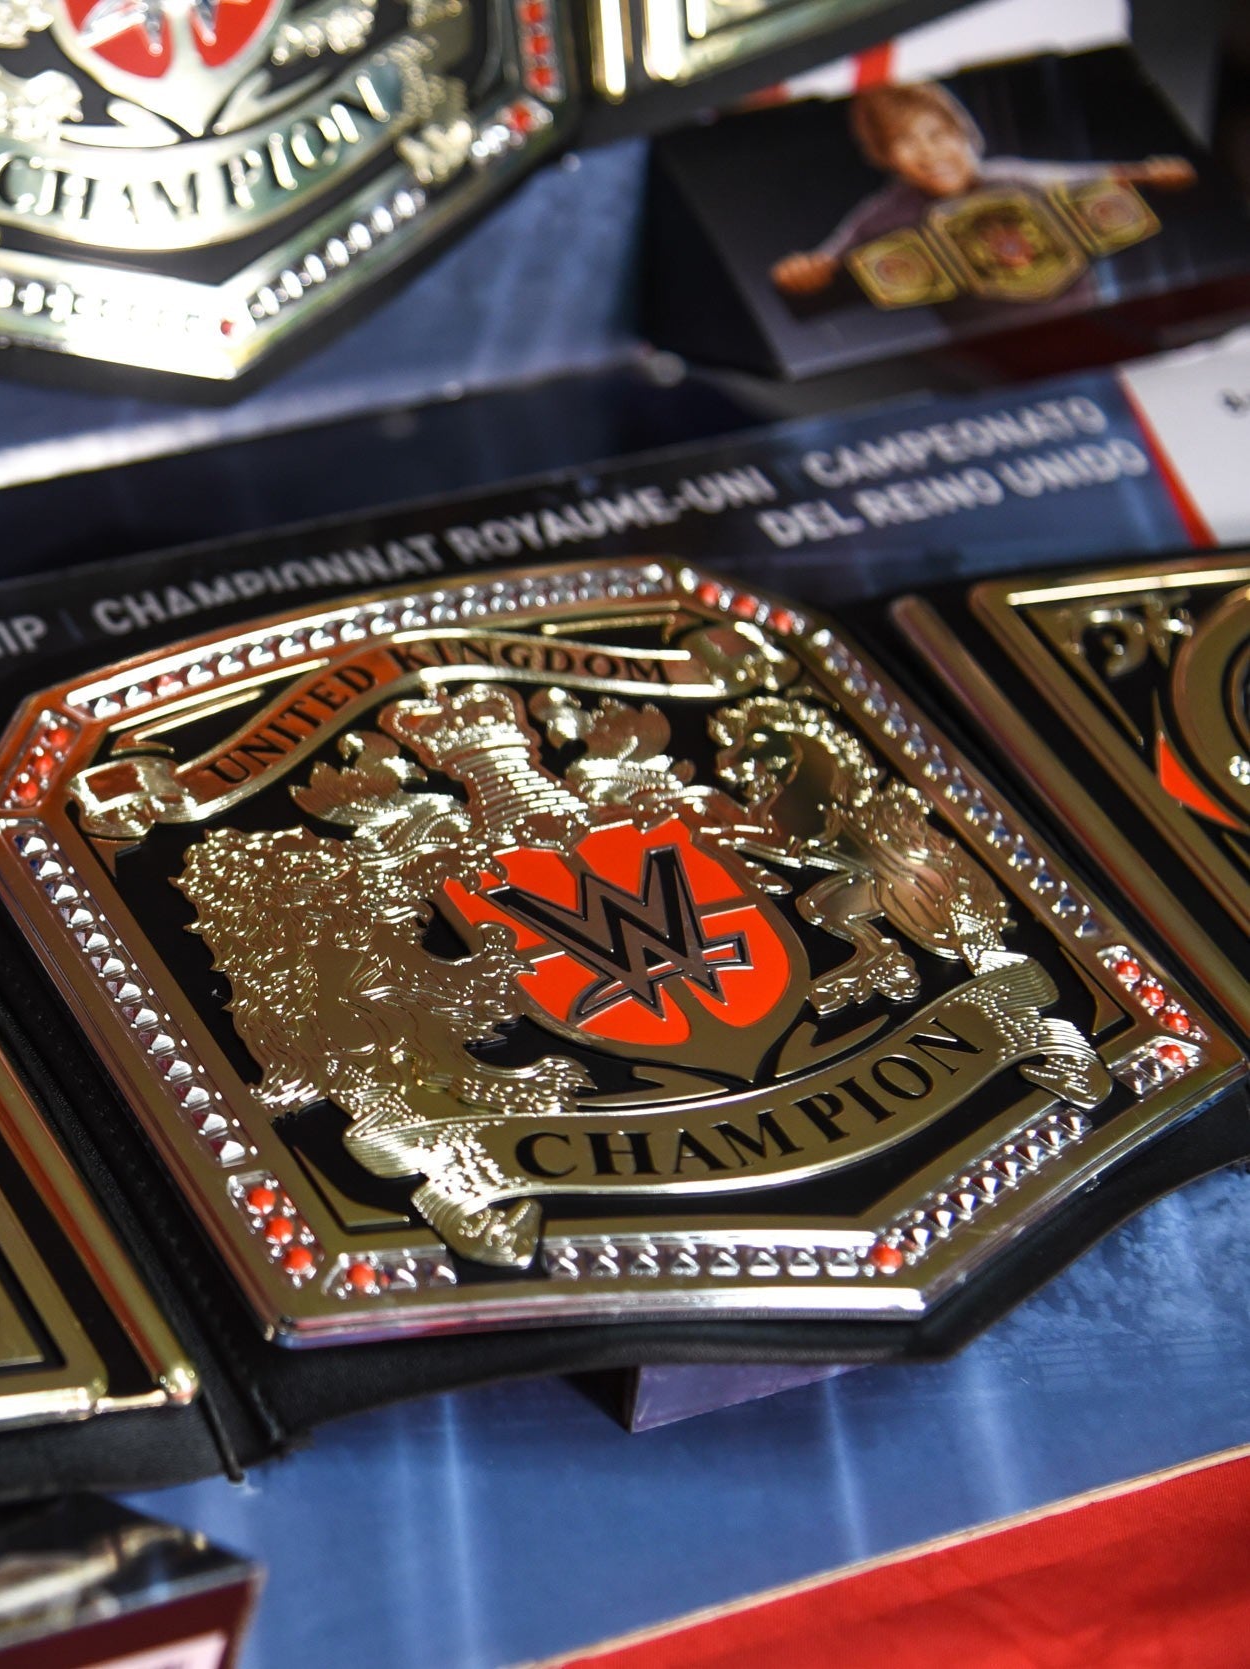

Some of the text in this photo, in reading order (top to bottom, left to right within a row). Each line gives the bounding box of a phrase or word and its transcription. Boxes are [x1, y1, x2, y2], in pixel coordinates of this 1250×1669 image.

[756, 438, 1149, 548] DEL REINO UNIDO
[801, 396, 1108, 489] CAMPEONATO
[92, 466, 777, 635] CHAMPIONNAT ROYAUME-UNI
[197, 636, 675, 785] UNITED KINGDOM
[514, 1015, 986, 1180] CHAMPION
